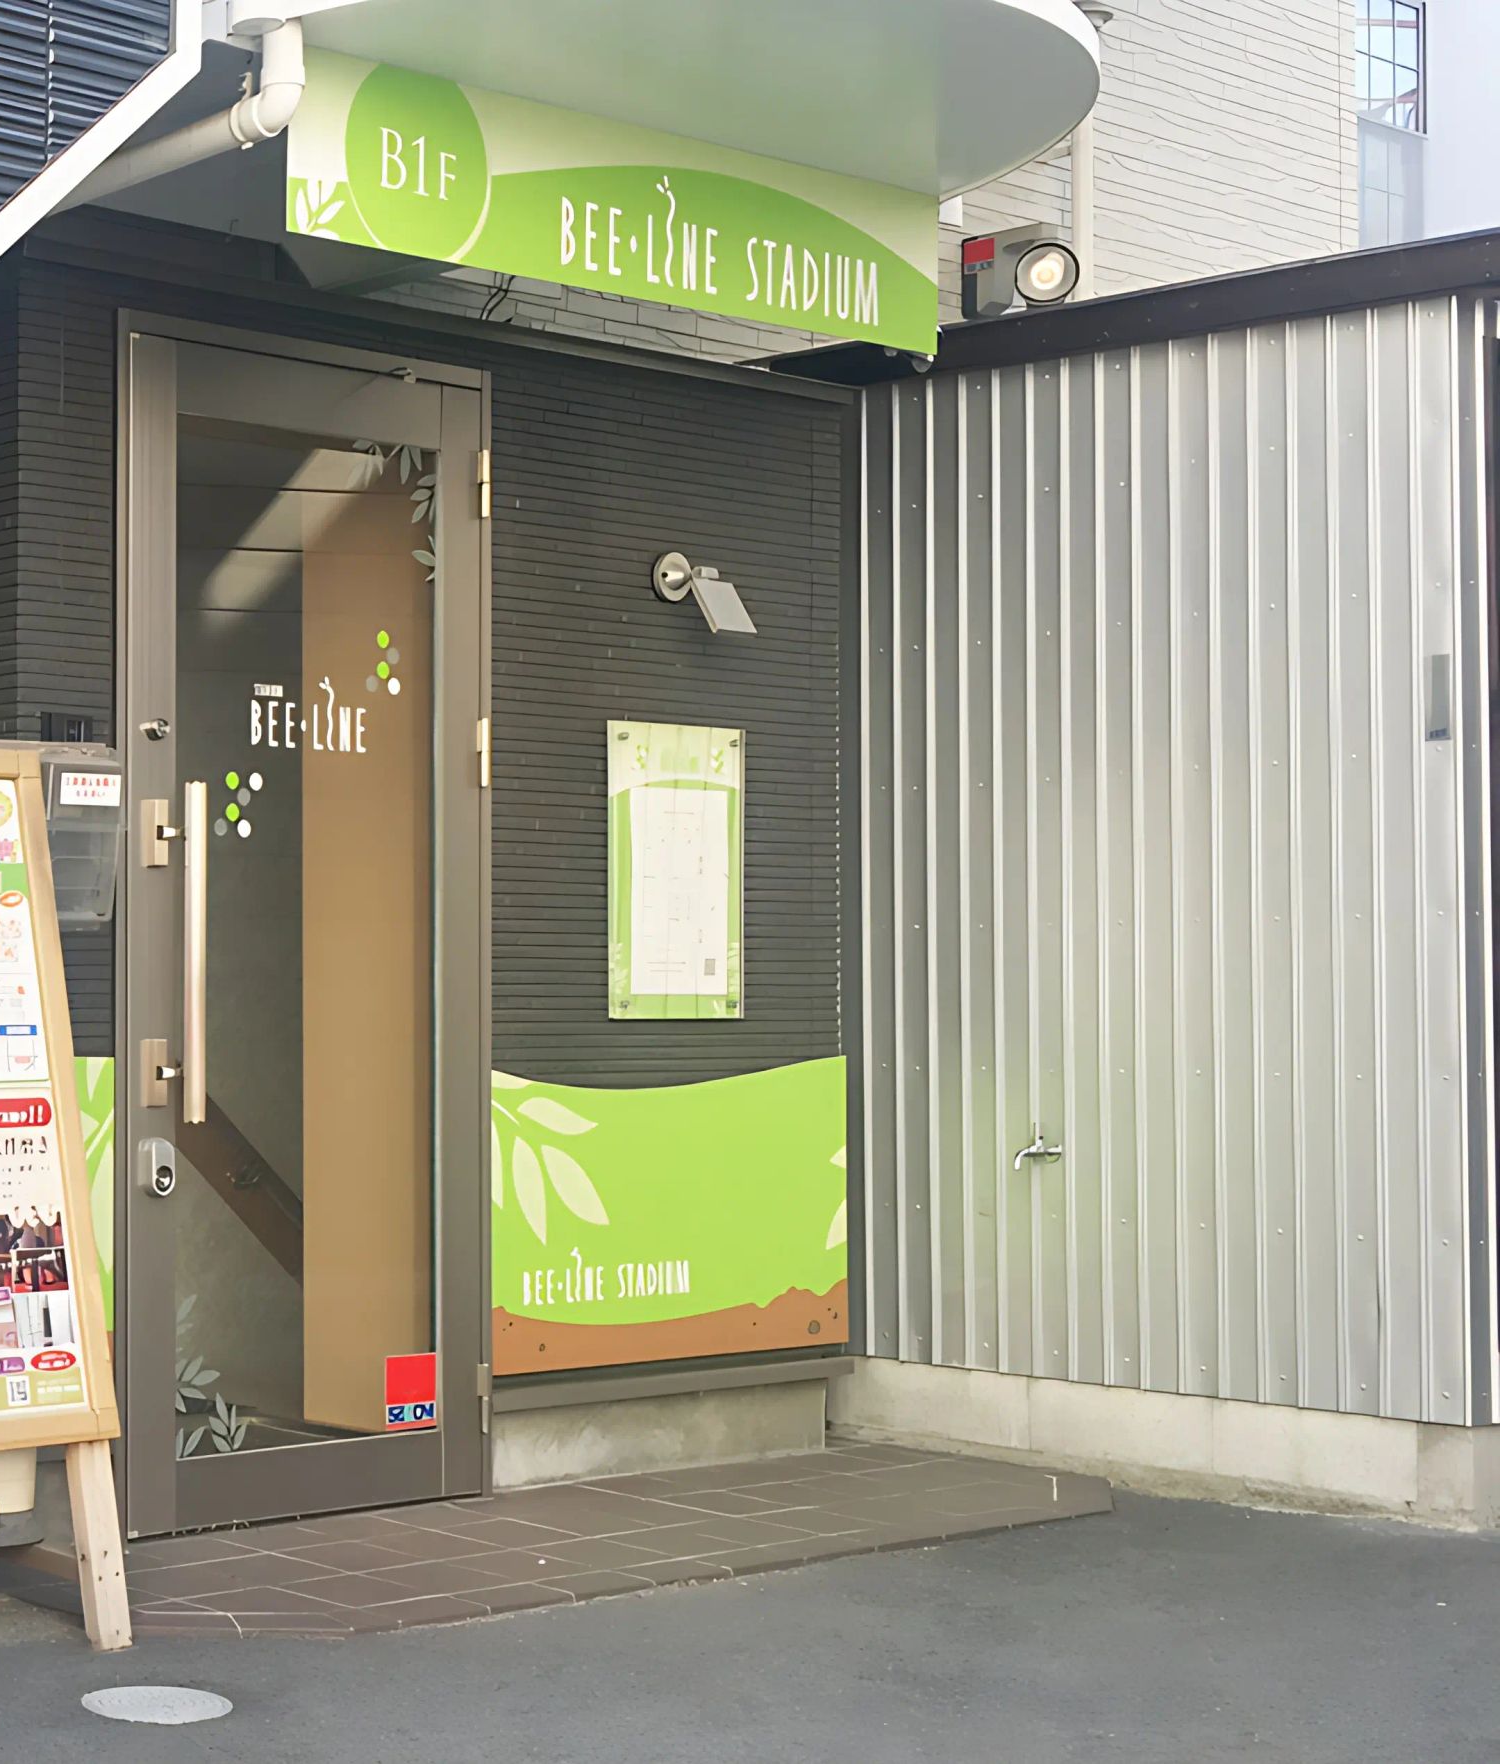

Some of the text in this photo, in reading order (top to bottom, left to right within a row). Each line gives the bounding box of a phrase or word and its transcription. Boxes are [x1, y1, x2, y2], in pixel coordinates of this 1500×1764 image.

[378, 126, 457, 202] B1F
[745, 236, 879, 327] STADIUM
[616, 1259, 691, 1299] STADIUM
